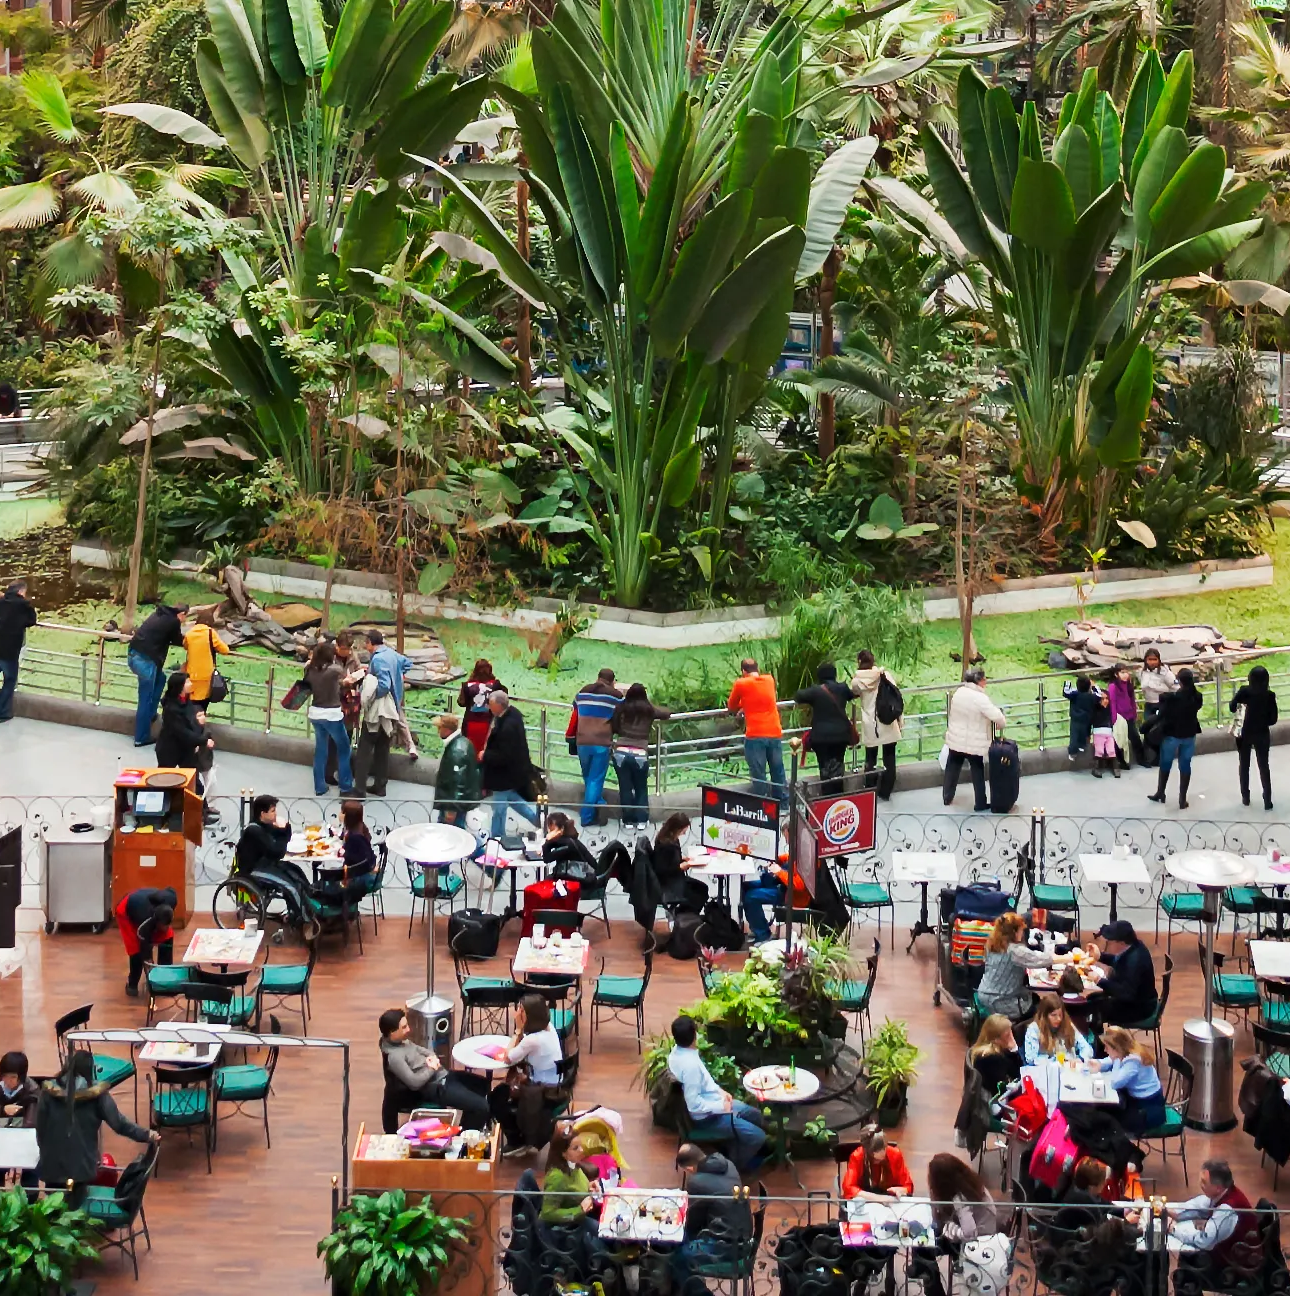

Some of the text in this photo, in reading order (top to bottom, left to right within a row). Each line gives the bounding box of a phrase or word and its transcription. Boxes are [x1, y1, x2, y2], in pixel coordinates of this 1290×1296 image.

[724, 802, 769, 822] LaBarrila
[829, 807, 854, 825] BURGER
[829, 814, 855, 835] KING
